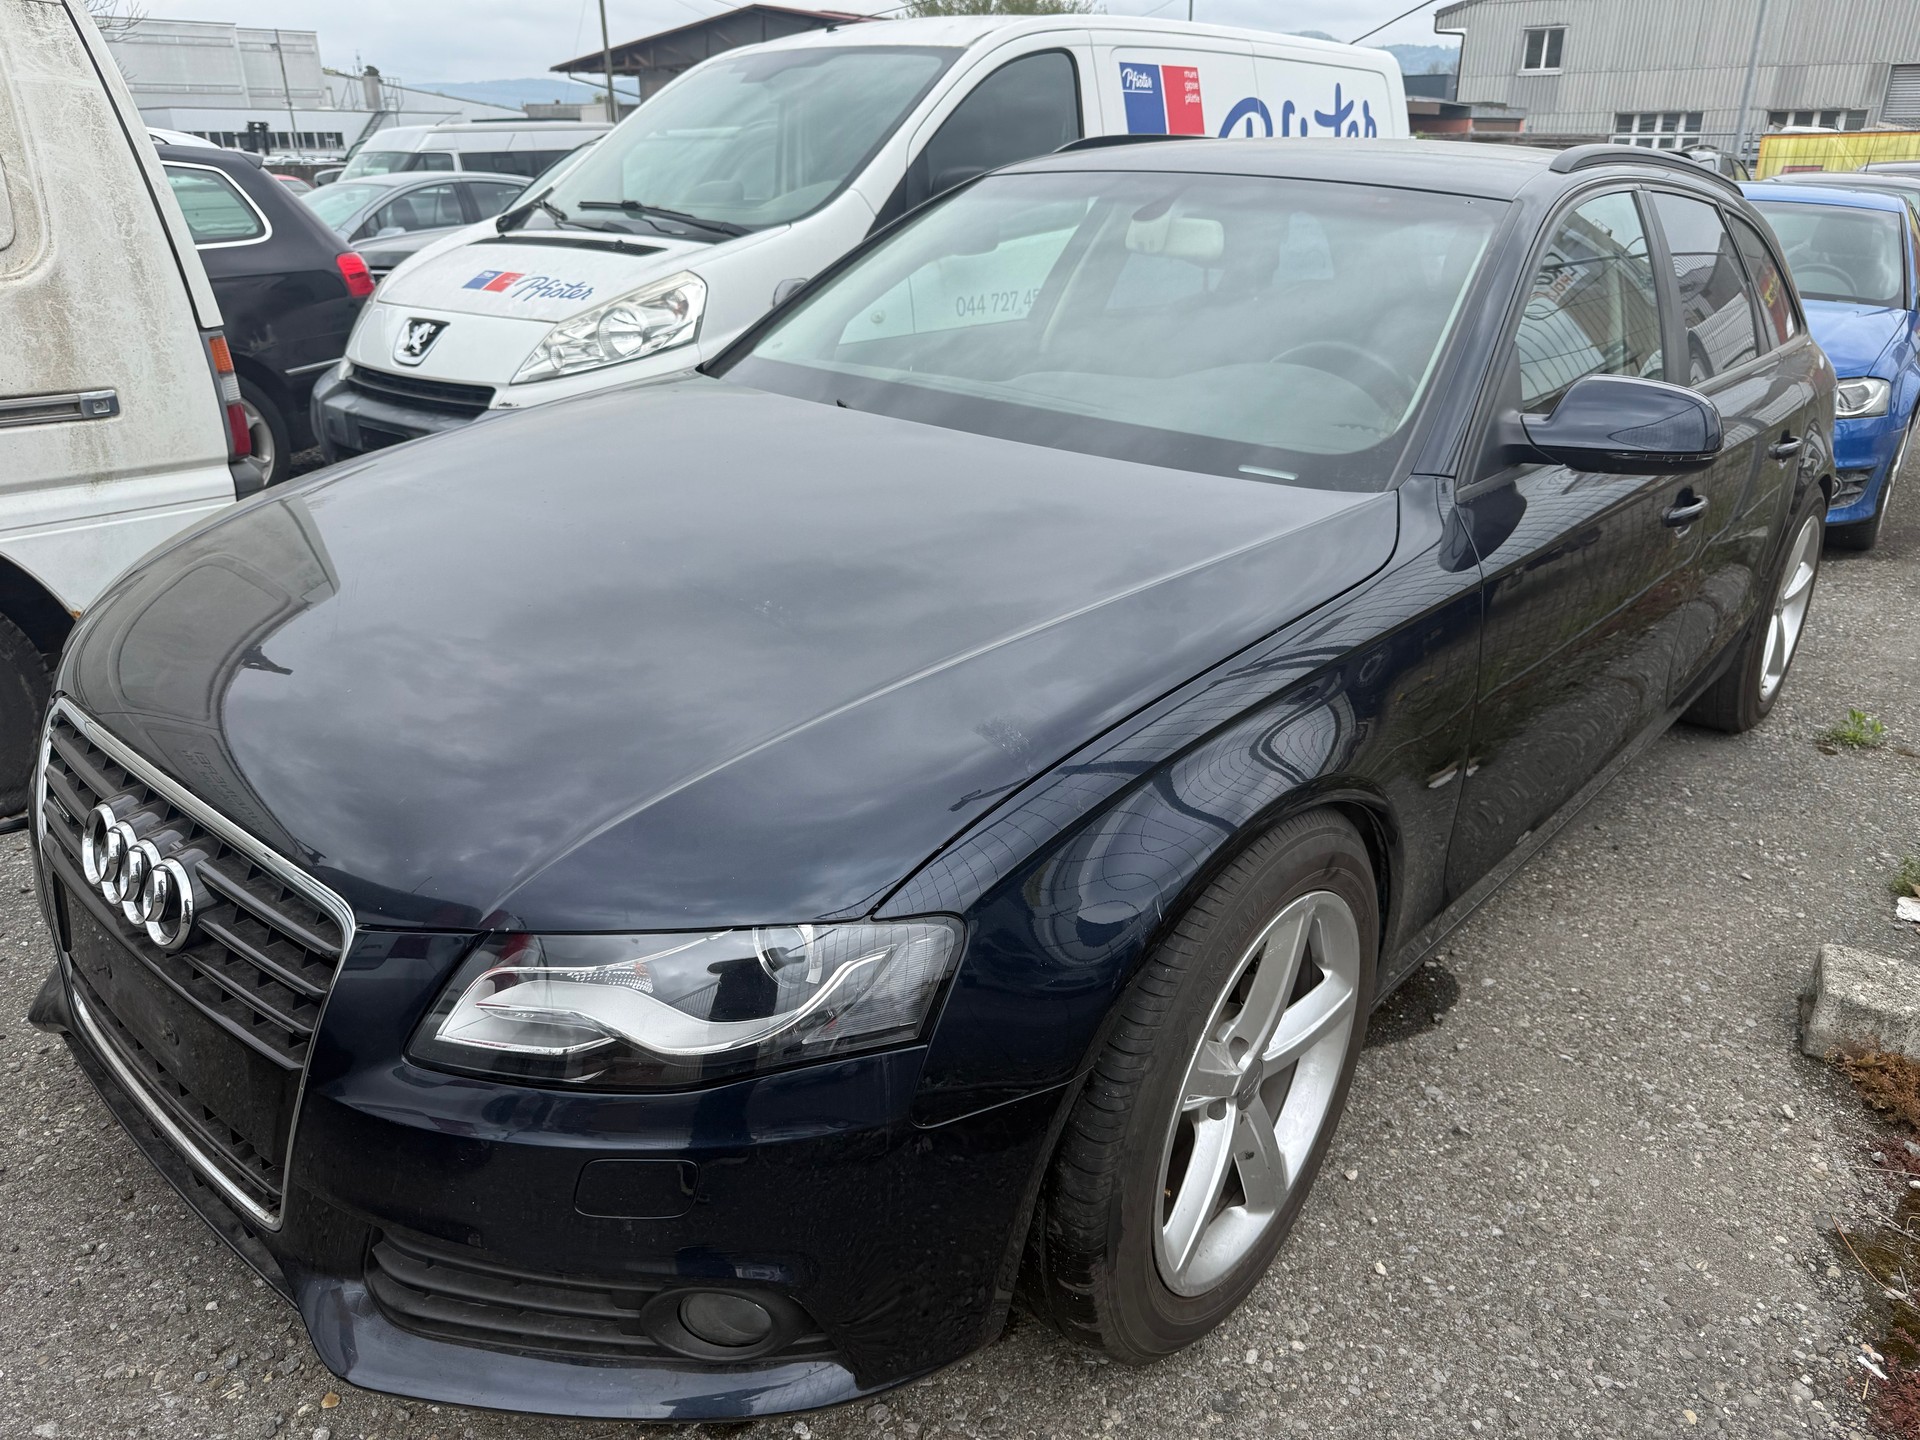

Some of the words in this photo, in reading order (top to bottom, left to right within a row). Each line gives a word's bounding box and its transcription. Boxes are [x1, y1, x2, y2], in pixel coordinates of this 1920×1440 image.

[1122, 68, 1152, 90] Pfister
[511, 276, 594, 301] Pfister
[956, 294, 986, 317] 044
[991, 291, 1018, 313] 727
[1188, 891, 1271, 1017] YOKOHAMA
